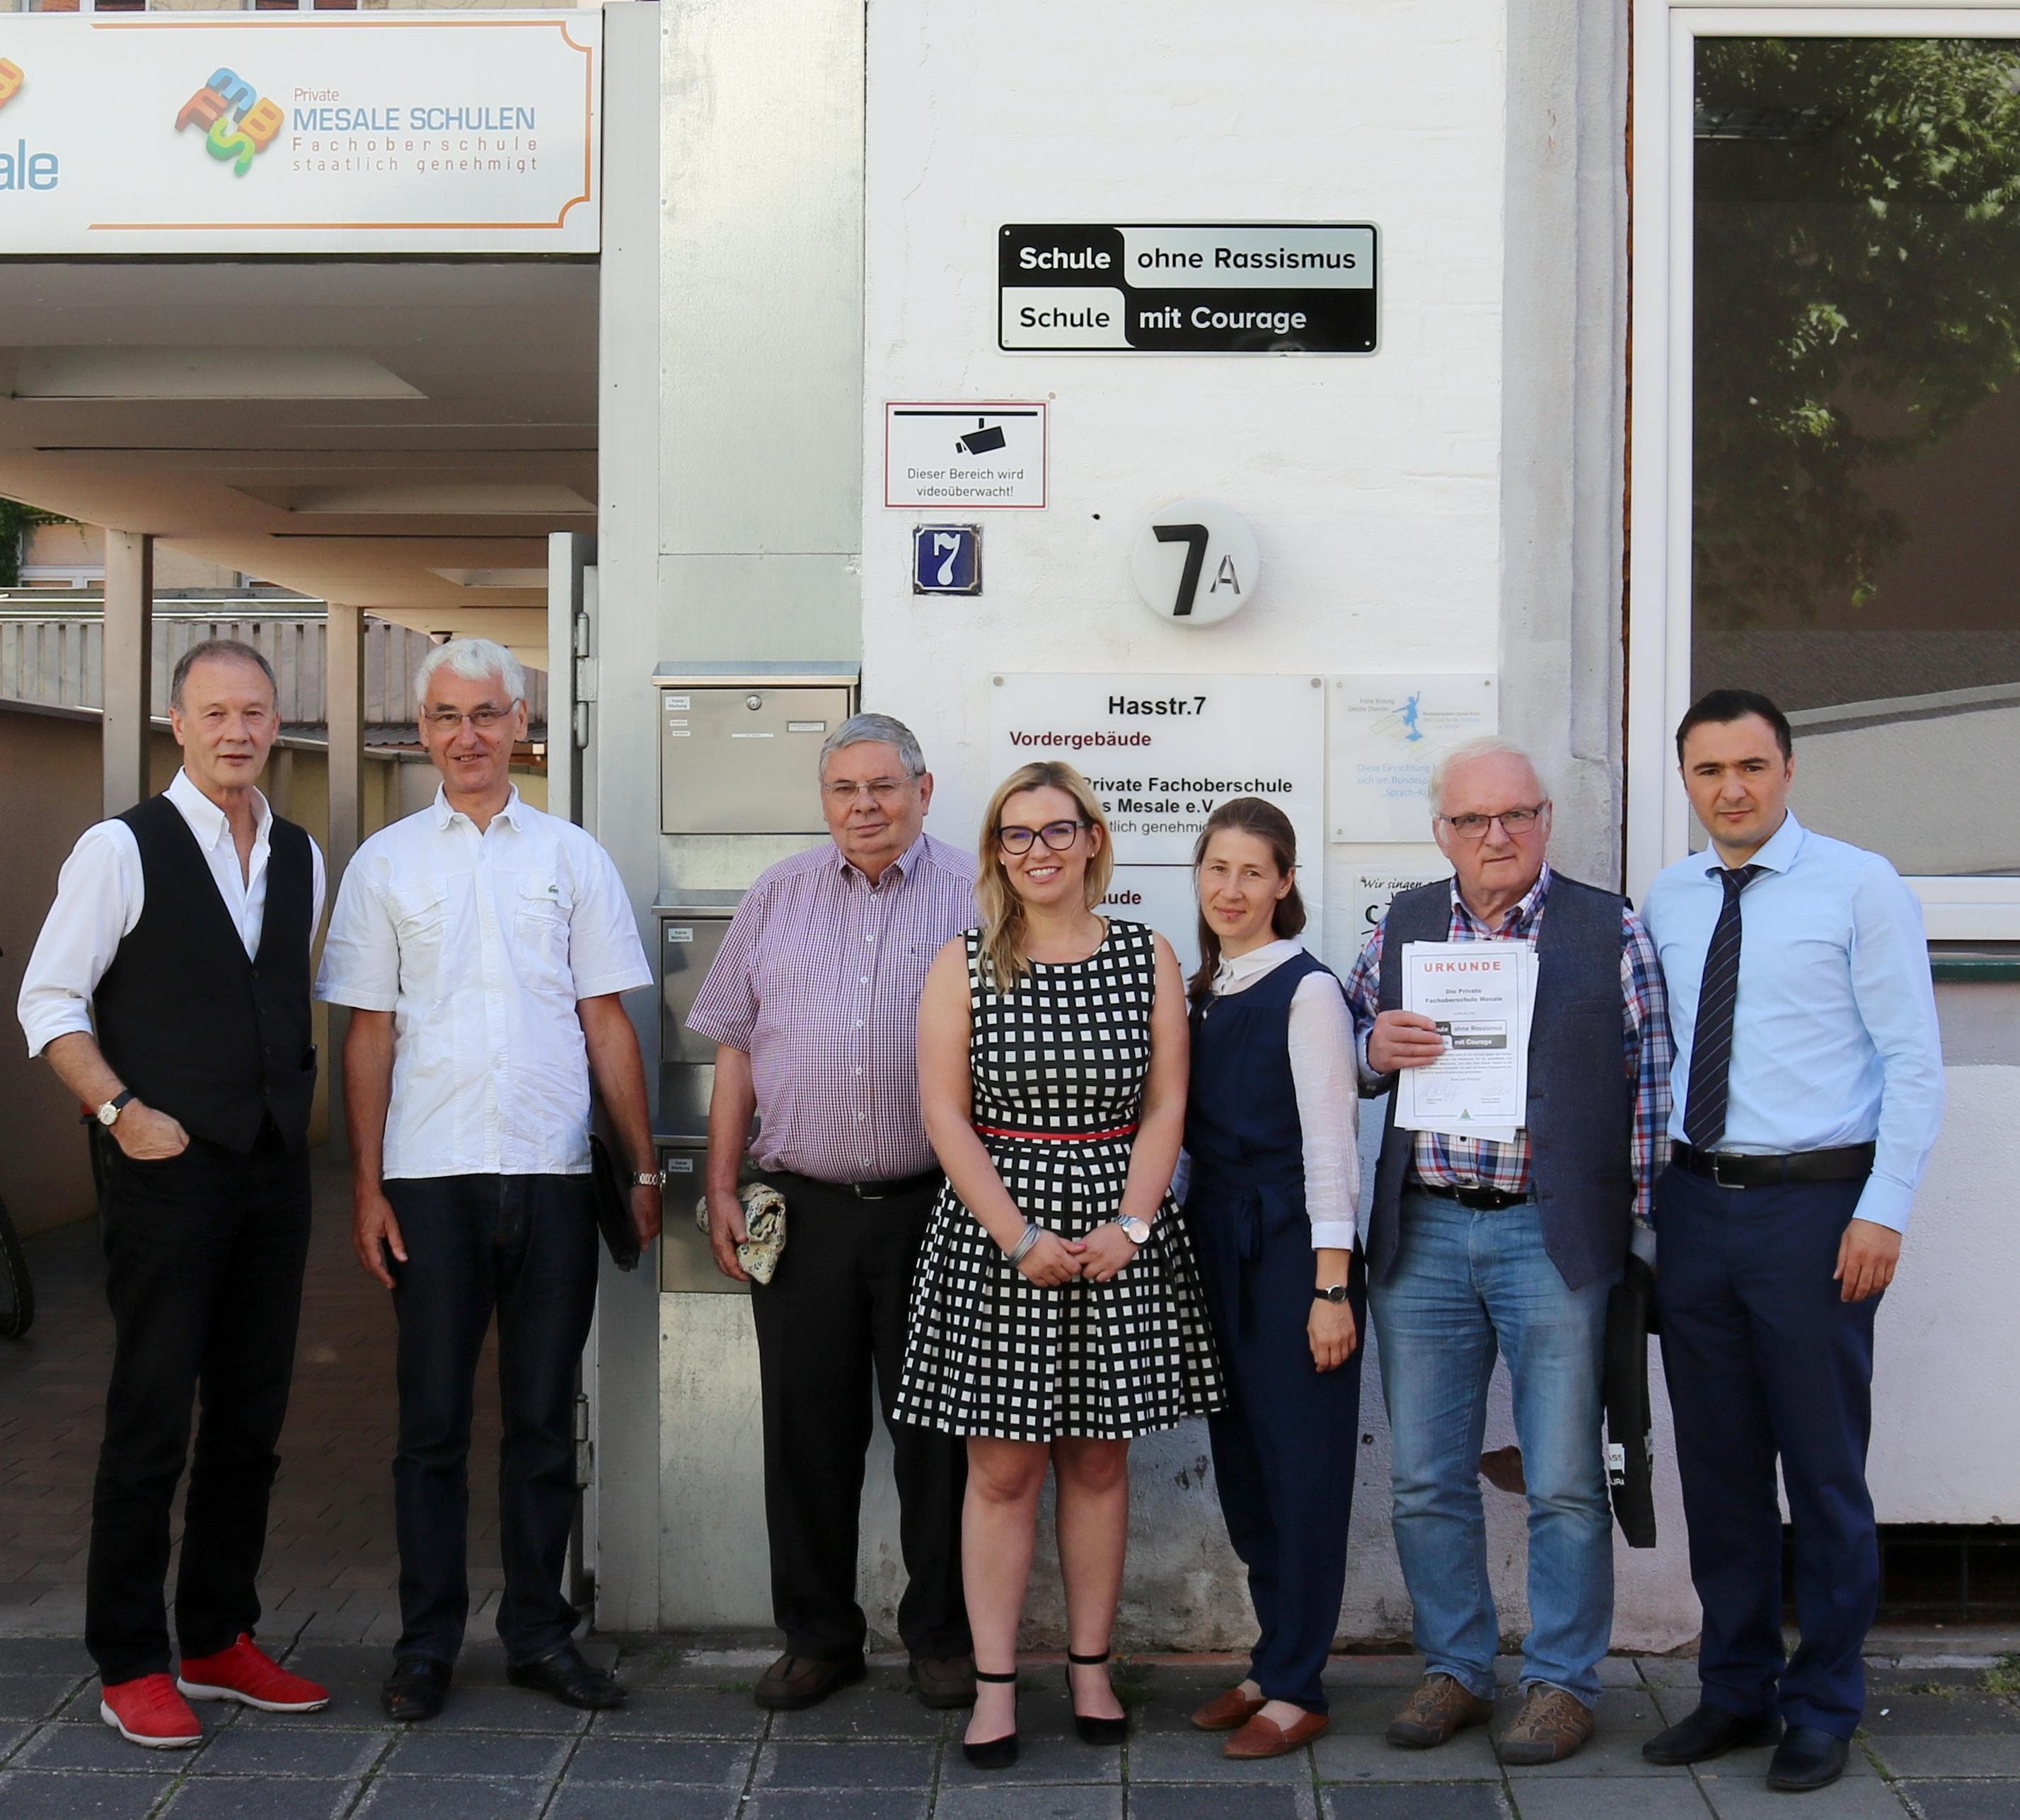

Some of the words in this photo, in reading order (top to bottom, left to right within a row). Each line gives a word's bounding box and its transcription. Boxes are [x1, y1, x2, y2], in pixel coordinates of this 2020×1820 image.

[294, 87, 340, 103] Private
[293, 108, 400, 132] MESALE
[410, 107, 536, 131] SCHULEN
[292, 136, 538, 153] Fachoberschule
[292, 156, 398, 172] staatlich
[417, 156, 538, 175] genehmigt
[1019, 247, 1111, 269] Schule
[1137, 248, 1204, 269] ohne
[1215, 247, 1356, 269] Rassismus
[1020, 307, 1110, 328] Schule
[1139, 306, 1182, 329] mit
[1191, 306, 1307, 335] Courage
[907, 468, 946, 480] Dieser
[950, 468, 994, 480] Bereich
[997, 468, 1024, 480] wird
[916, 485, 1014, 498] videoüberwacht!
[933, 532, 961, 586] 7
[1109, 695, 1206, 715] Hasstr.7
[1010, 731, 1152, 750] Vordergebäude
[1357, 763, 1380, 772] Diese
[1382, 763, 1431, 775] Einrichtung
[1148, 777, 1293, 793] Fachoberschule
[1358, 776, 1374, 784] sich
[1118, 798, 1180, 813] Mesale
[1363, 878, 1385, 889] Wir
[1424, 961, 1501, 973] URKUNDE
